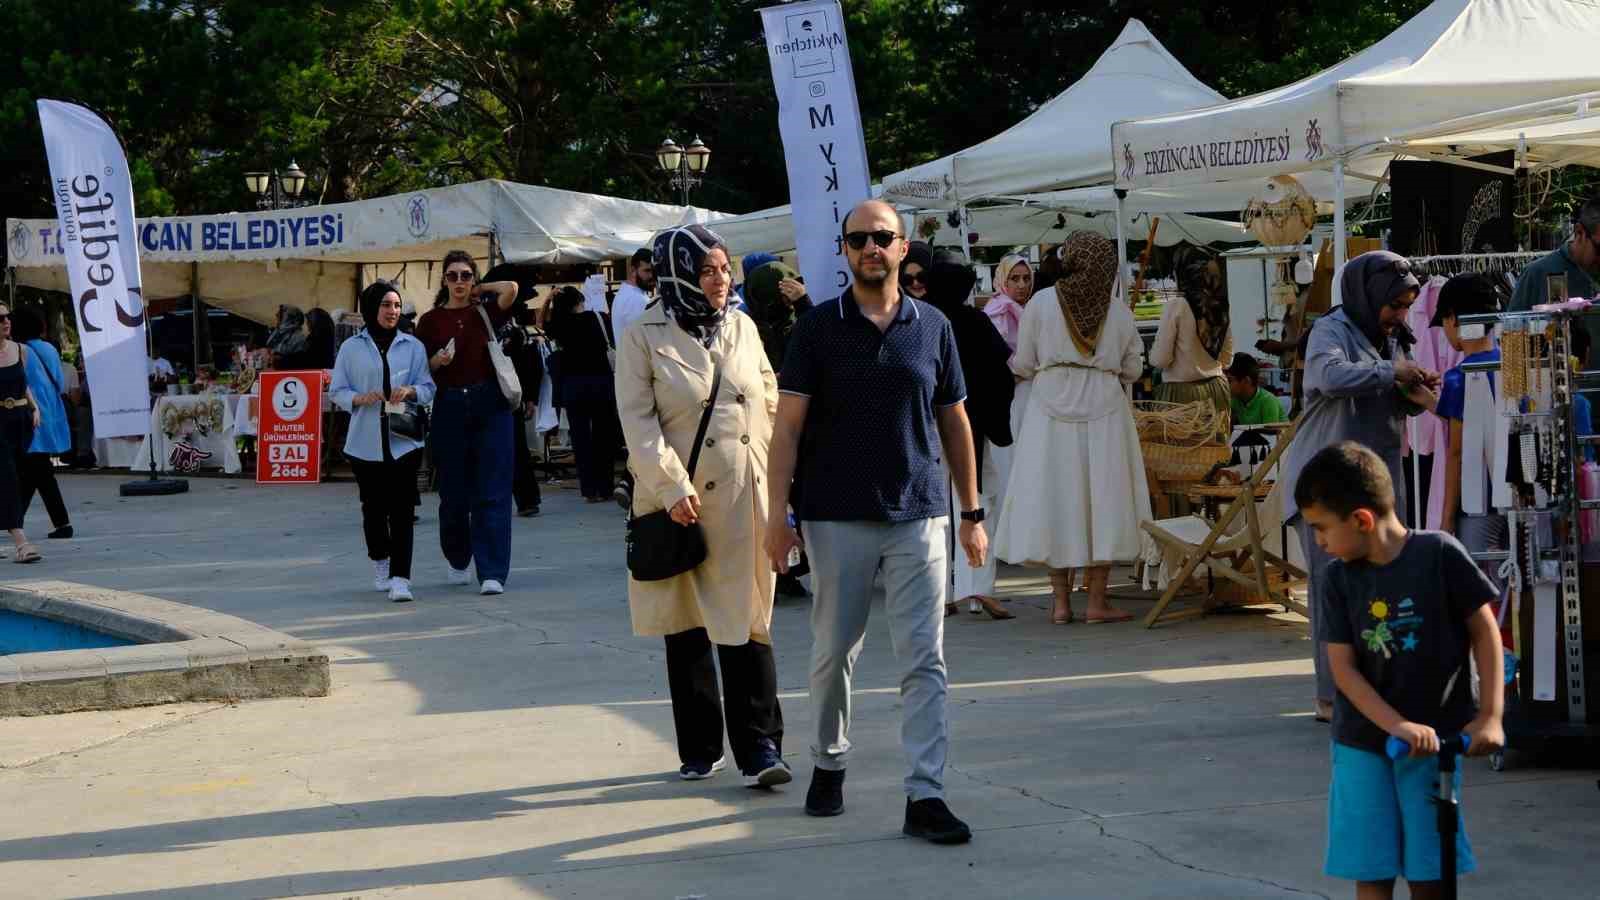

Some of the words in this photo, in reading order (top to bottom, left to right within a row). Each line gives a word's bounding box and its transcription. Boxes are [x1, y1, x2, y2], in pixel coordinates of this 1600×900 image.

[1144, 142, 1208, 175] ERZİNCAN
[1209, 128, 1290, 168] BELEDİYESİ
[201, 213, 343, 251] BELEDİYESİ
[272, 446, 281, 460] 3
[285, 446, 306, 460] AL
